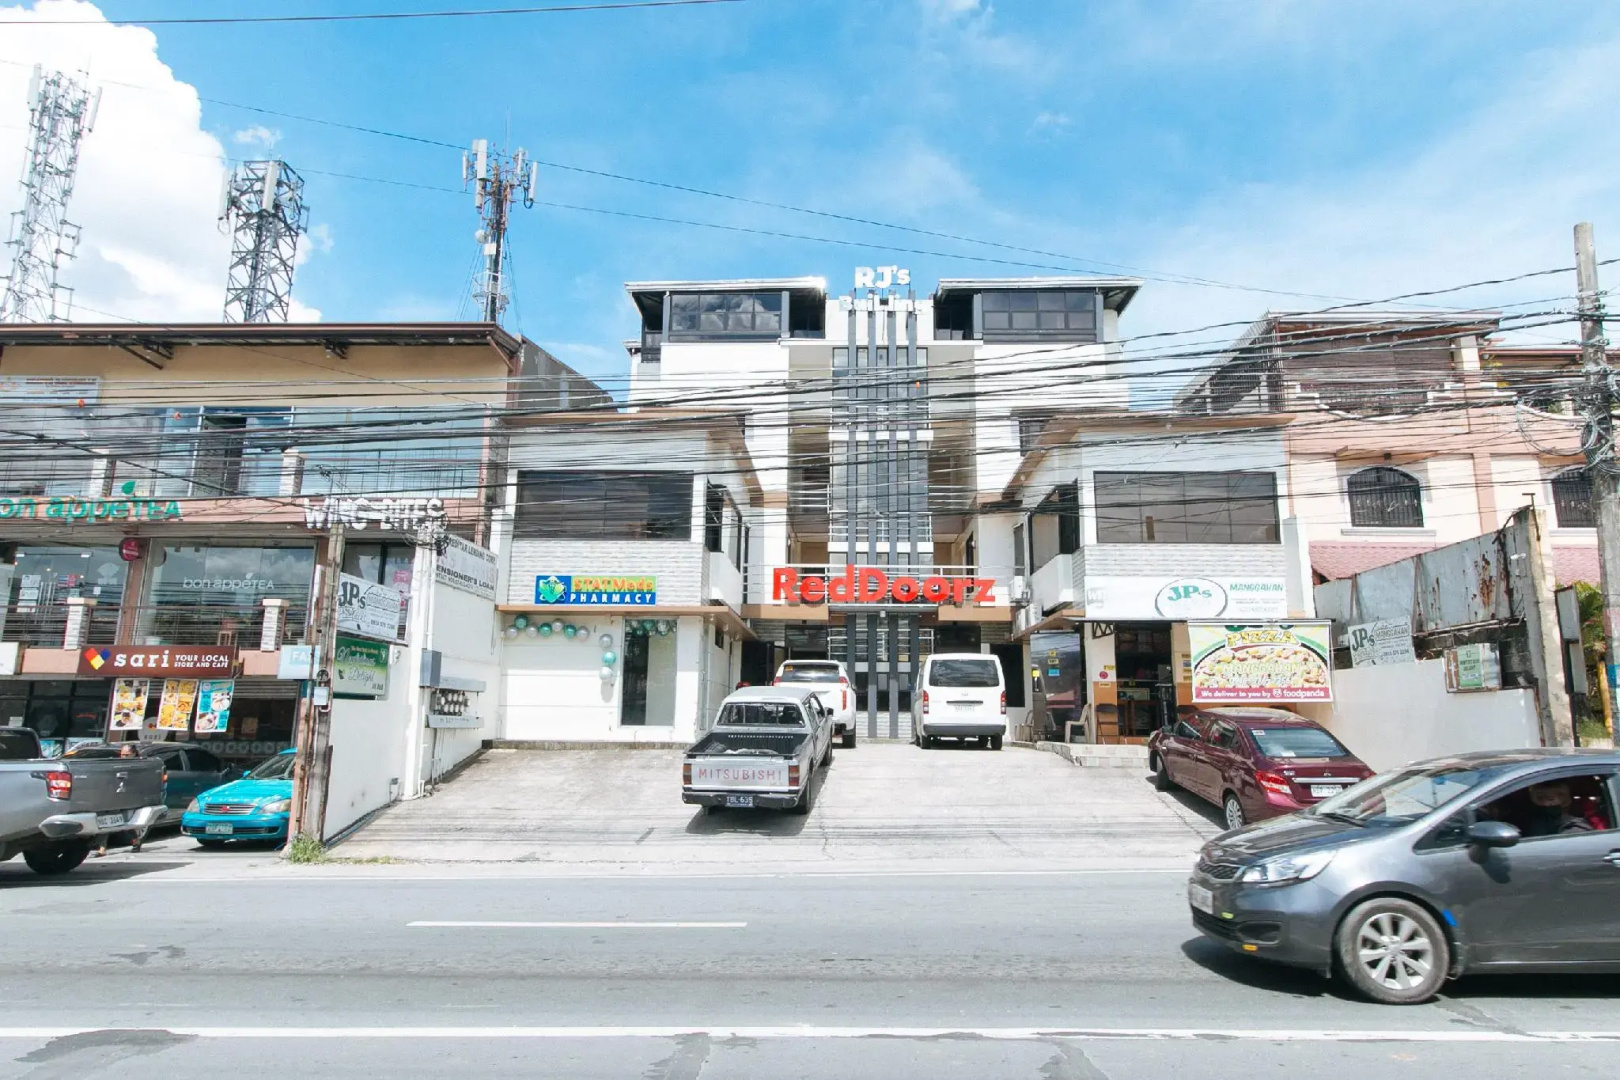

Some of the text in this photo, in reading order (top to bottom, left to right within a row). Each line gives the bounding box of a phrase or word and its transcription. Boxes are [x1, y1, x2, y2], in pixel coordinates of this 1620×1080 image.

[855, 265, 911, 288] RJ's
[0, 497, 35, 519] on
[183, 577, 211, 589] bon
[436, 564, 478, 586] ENSIONER'S
[478, 579, 495, 591] LOAN
[772, 563, 996, 603] RedDoorz
[569, 593, 652, 604] PHARMACY
[1226, 630, 1298, 647] PIZZA
[114, 649, 229, 668] sari YOUR LOCAL
[1262, 690, 1271, 699] by
[1283, 689, 1325, 698] foodpanda
[698, 768, 782, 780] MITSUBISHI
